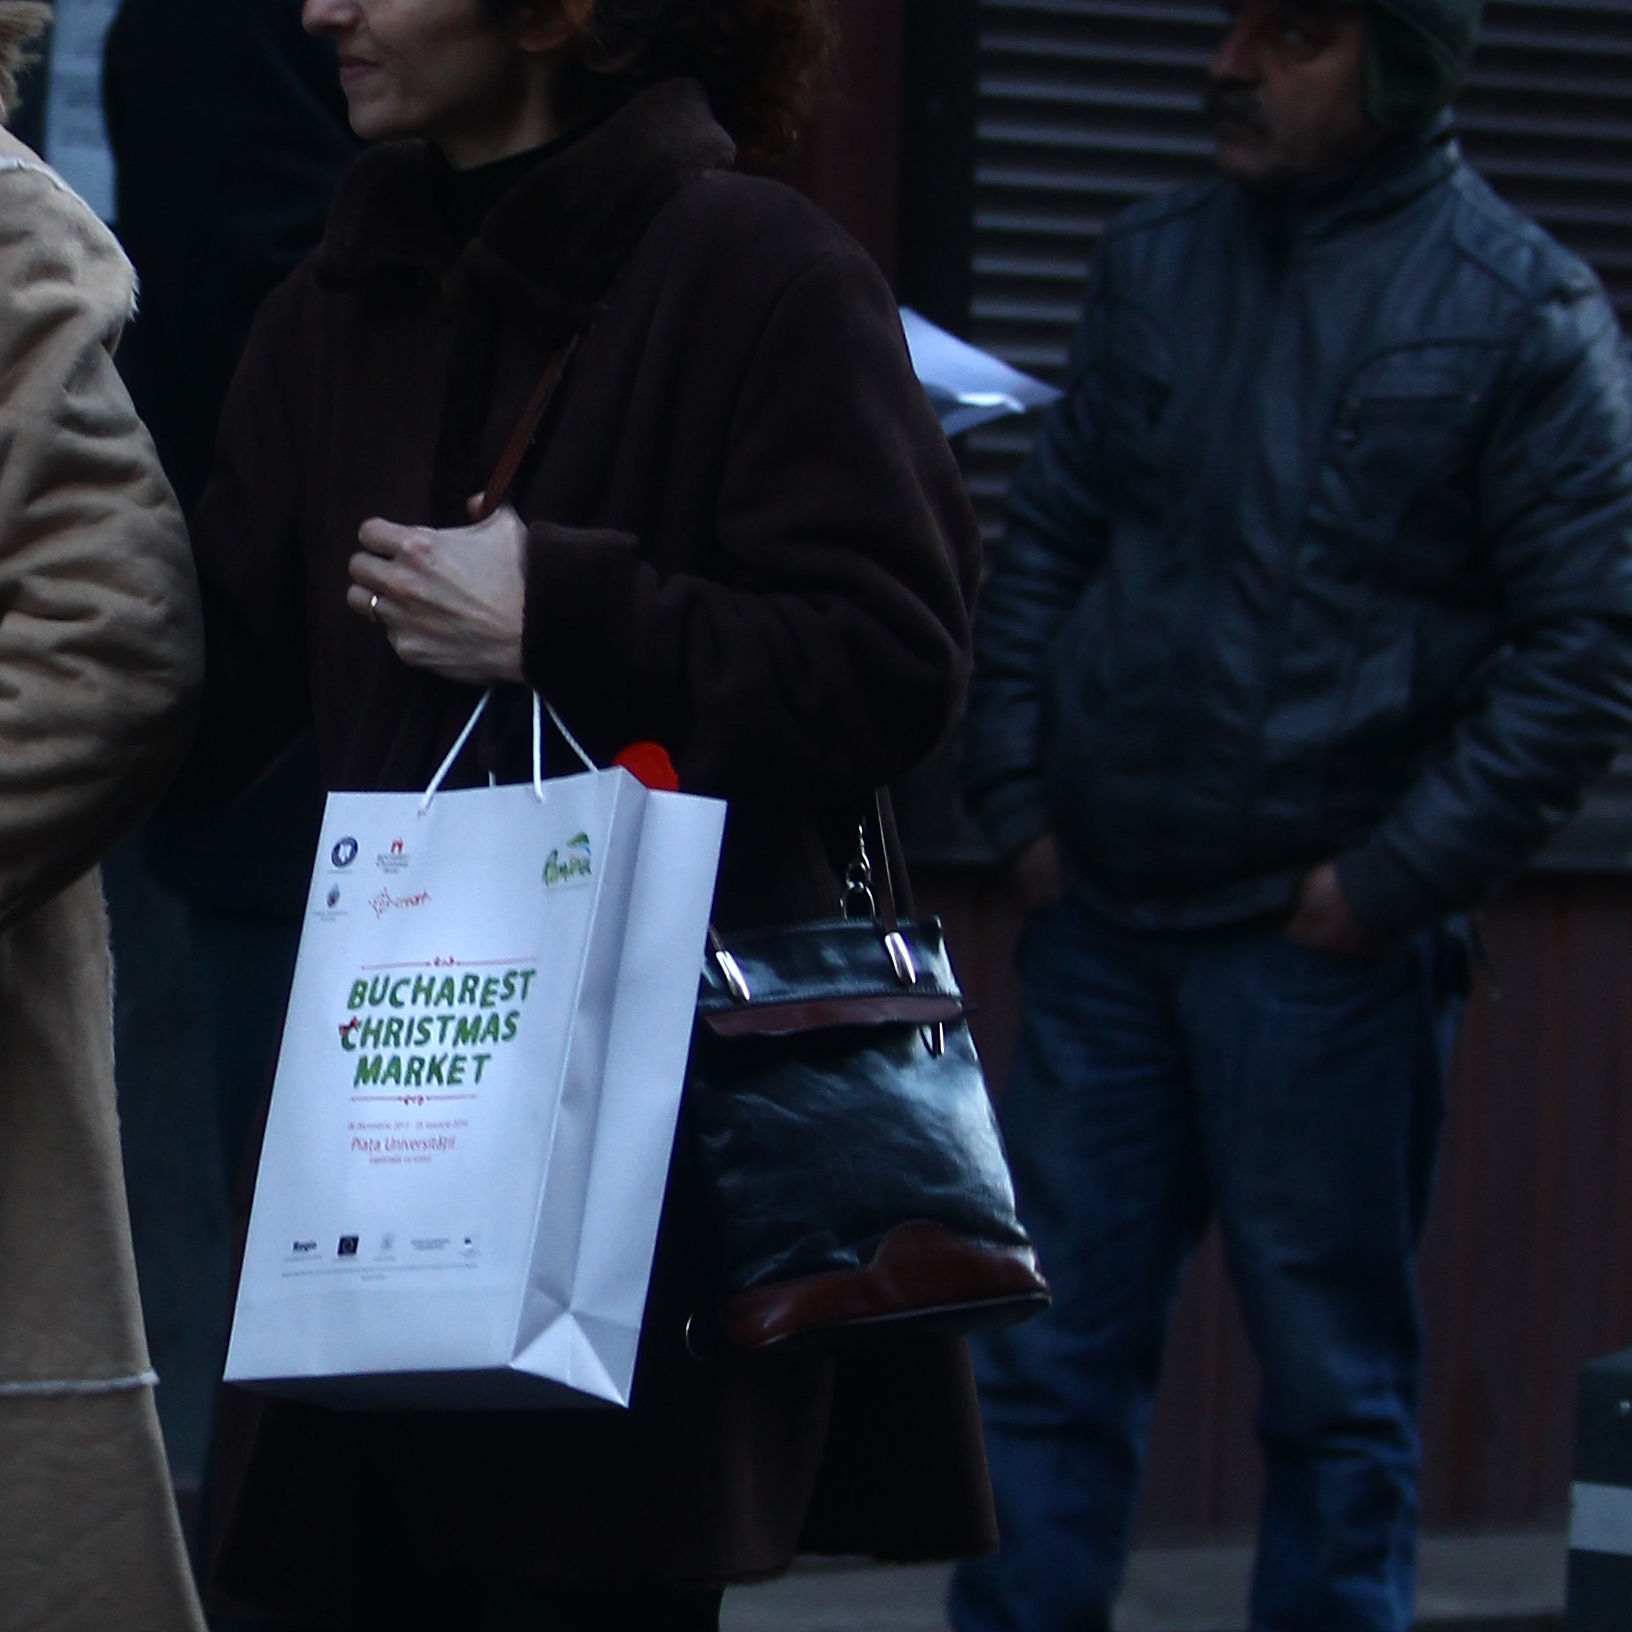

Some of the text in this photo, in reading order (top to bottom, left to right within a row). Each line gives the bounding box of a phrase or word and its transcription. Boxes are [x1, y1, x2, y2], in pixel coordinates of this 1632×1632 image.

[347, 968, 536, 1010] BUCHAREST
[338, 1009, 520, 1052] CHRISTMAS
[353, 1053, 492, 1088] MARKET
